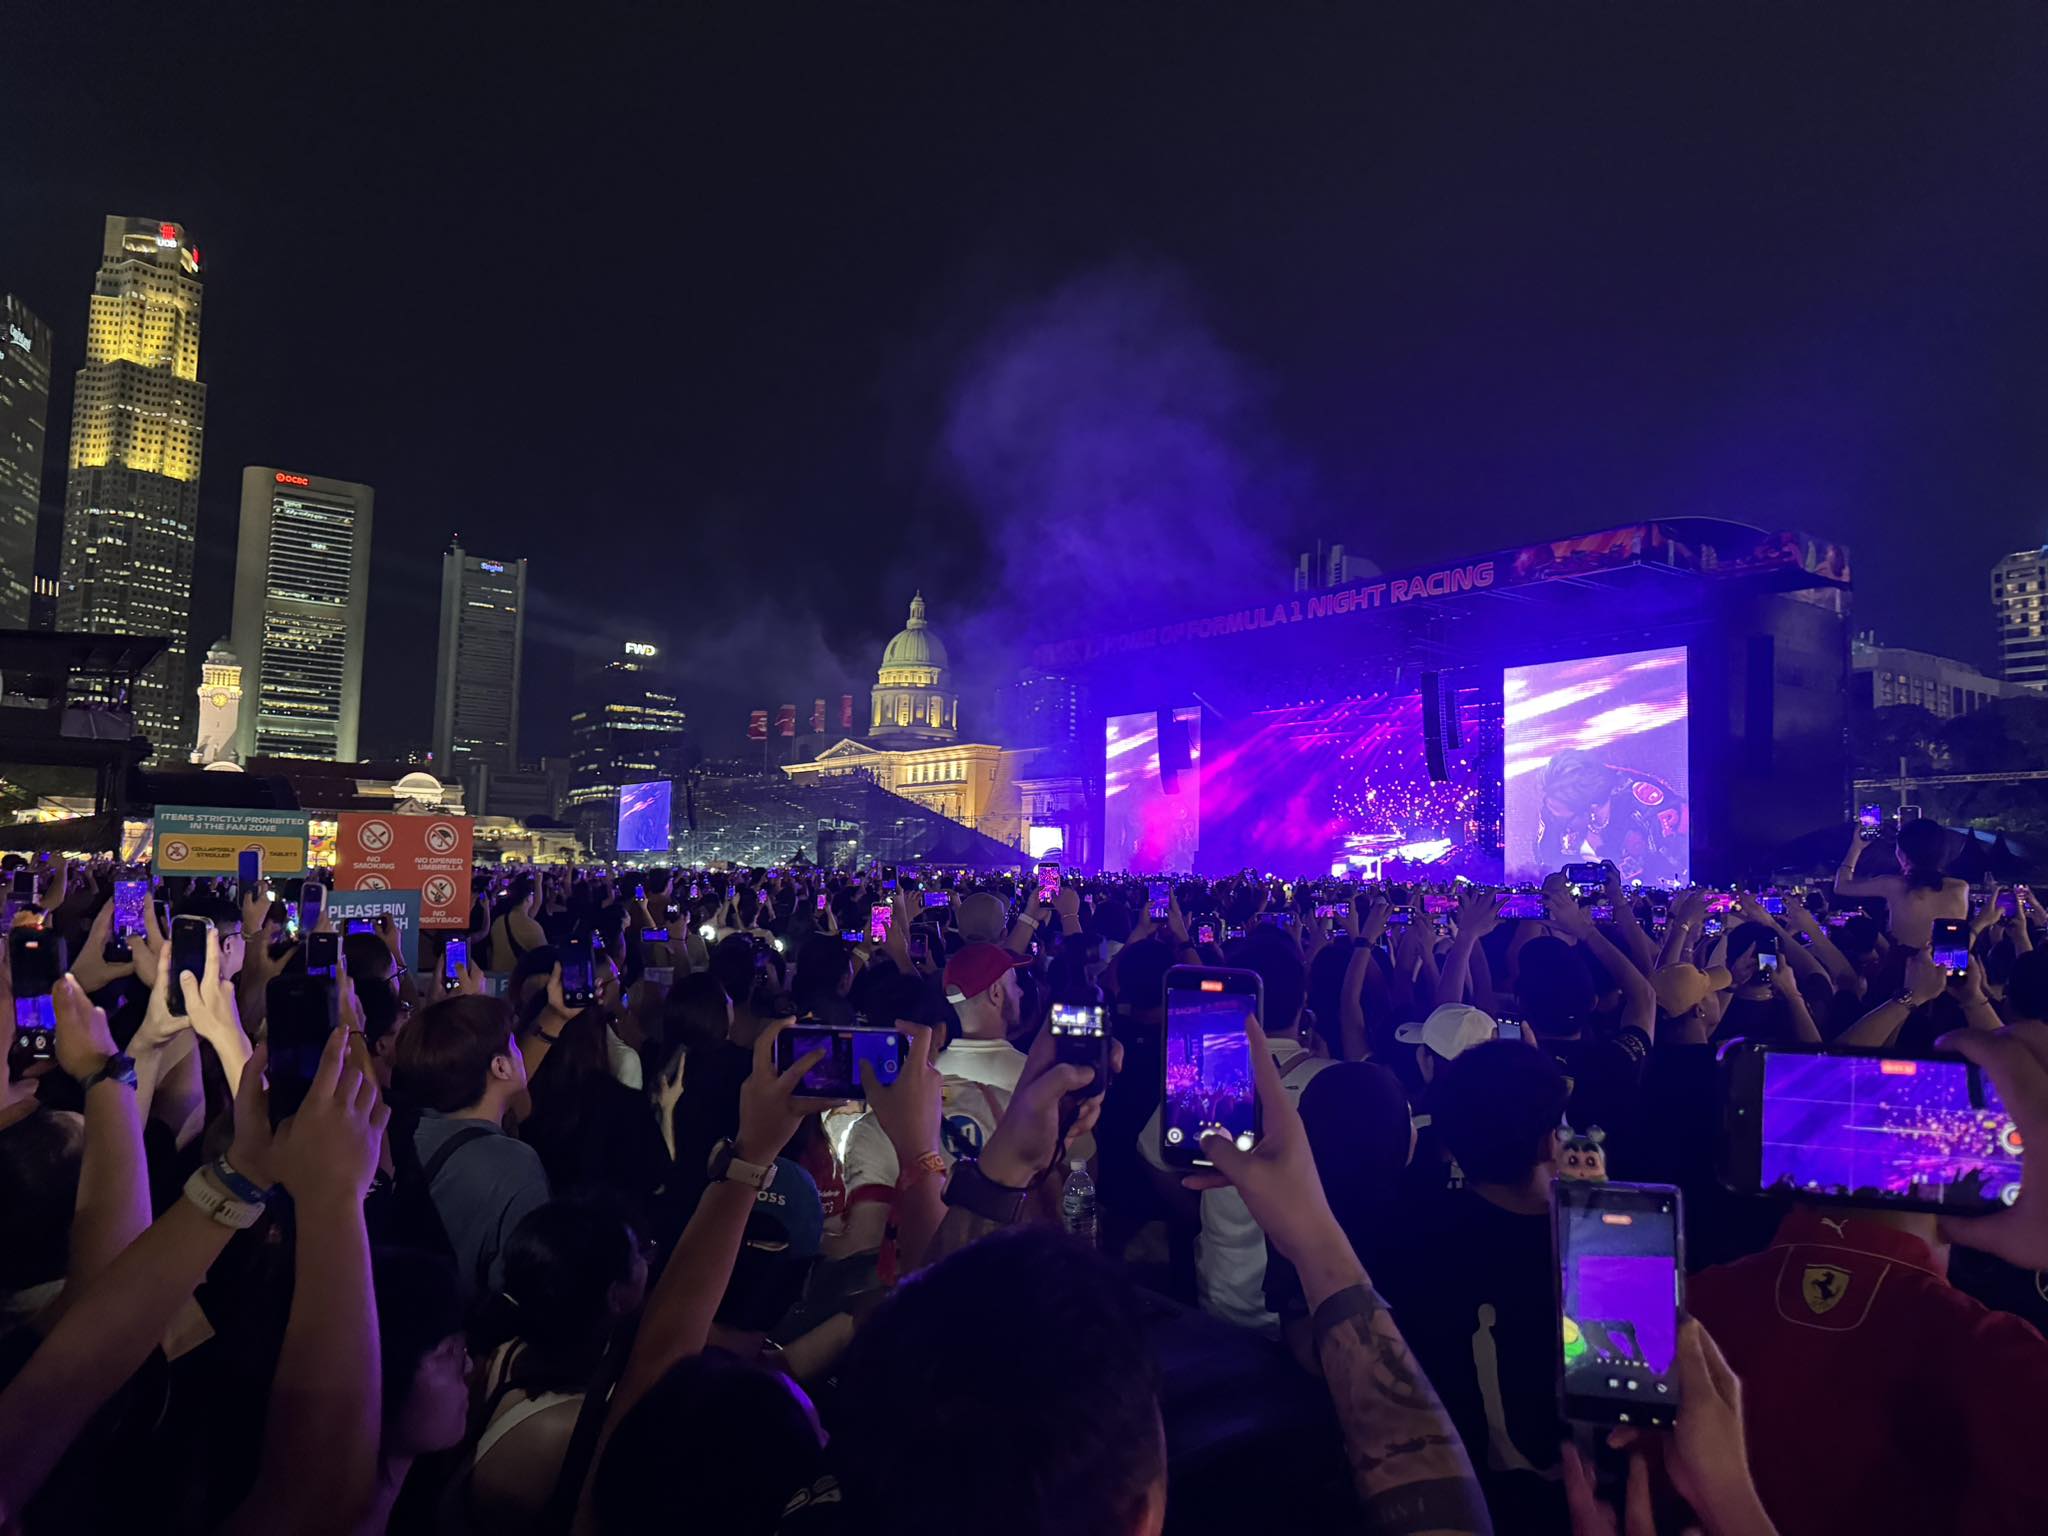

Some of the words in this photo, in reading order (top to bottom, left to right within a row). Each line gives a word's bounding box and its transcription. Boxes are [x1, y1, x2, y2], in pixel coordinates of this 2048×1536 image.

[285, 475, 308, 486] OCBC
[1188, 604, 1287, 640] FORMULA
[1290, 600, 1303, 622] 1
[1308, 583, 1386, 619] NIGHT
[1391, 562, 1495, 603] RACING
[625, 642, 656, 656] FWD
[160, 813, 194, 821] ITEMS
[196, 814, 243, 823] STRICTLY
[245, 816, 305, 825] PROHIBITED
[226, 823, 248, 831] FAN
[248, 824, 277, 832] ZONE
[353, 862, 395, 870] SMOKING
[328, 903, 381, 918] PLEASE
[757, 1191, 786, 1206] OSS
